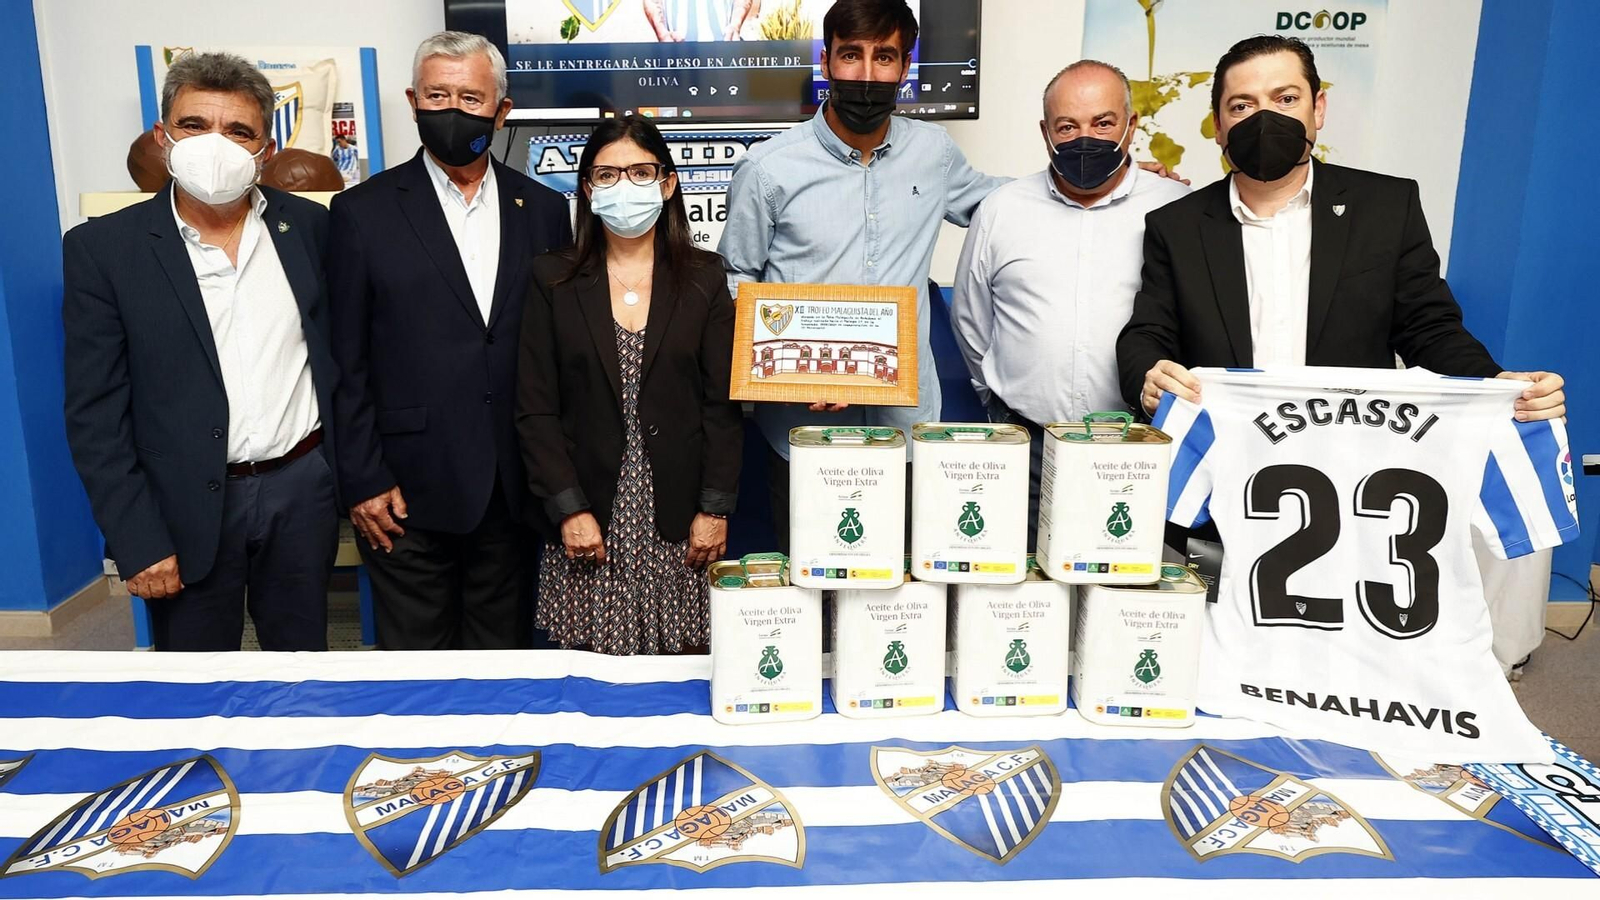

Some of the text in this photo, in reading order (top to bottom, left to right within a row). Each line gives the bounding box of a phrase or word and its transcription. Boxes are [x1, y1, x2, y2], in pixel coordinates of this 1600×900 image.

[1276, 10, 1367, 31] DCOOP
[516, 56, 801, 70] SE LE ENTREGARÁ SU PESO EN ACEITE DE
[638, 76, 679, 87] OLIVA
[332, 120, 356, 136] RCA
[688, 198, 727, 223] ala
[693, 230, 710, 243] de
[1252, 398, 1439, 445] ESCASSI
[817, 467, 884, 476] Aceite de Oliva
[939, 461, 1006, 470] Aceite de Oliva
[1092, 461, 1157, 470] Aceite de Oliva
[823, 477, 878, 487] Virgen Extra
[944, 471, 999, 480] Virgen Extra
[1097, 471, 1150, 481] Virgen Extra
[839, 517, 860, 536] A
[959, 511, 980, 530] A
[1107, 511, 1129, 531] A
[1244, 464, 1448, 640] 23
[739, 606, 801, 616] Aceite de Oliva
[865, 602, 928, 612] Aceite de Oliva
[987, 600, 1051, 609] Aceite de Oliva
[744, 617, 796, 627] Virgen Extra
[870, 612, 922, 622] Virgen Extra
[992, 610, 1045, 620] Virgen Extra
[1119, 609, 1186, 620] Aceite de Oliva
[1124, 619, 1178, 629] Virgen Extra
[758, 655, 779, 673] A
[883, 650, 904, 667] A
[1006, 649, 1027, 666] A
[1134, 658, 1156, 676] A
[1239, 683, 1480, 740] BENAHAVIS
[922, 754, 1030, 804] MALAGA C.F.
[375, 759, 521, 816] MALAGA C.F.
[1202, 787, 1298, 849] MALAGA C.F.
[28, 800, 210, 868] MALAGA C.F.
[620, 794, 757, 861] MALAGA C.F.
